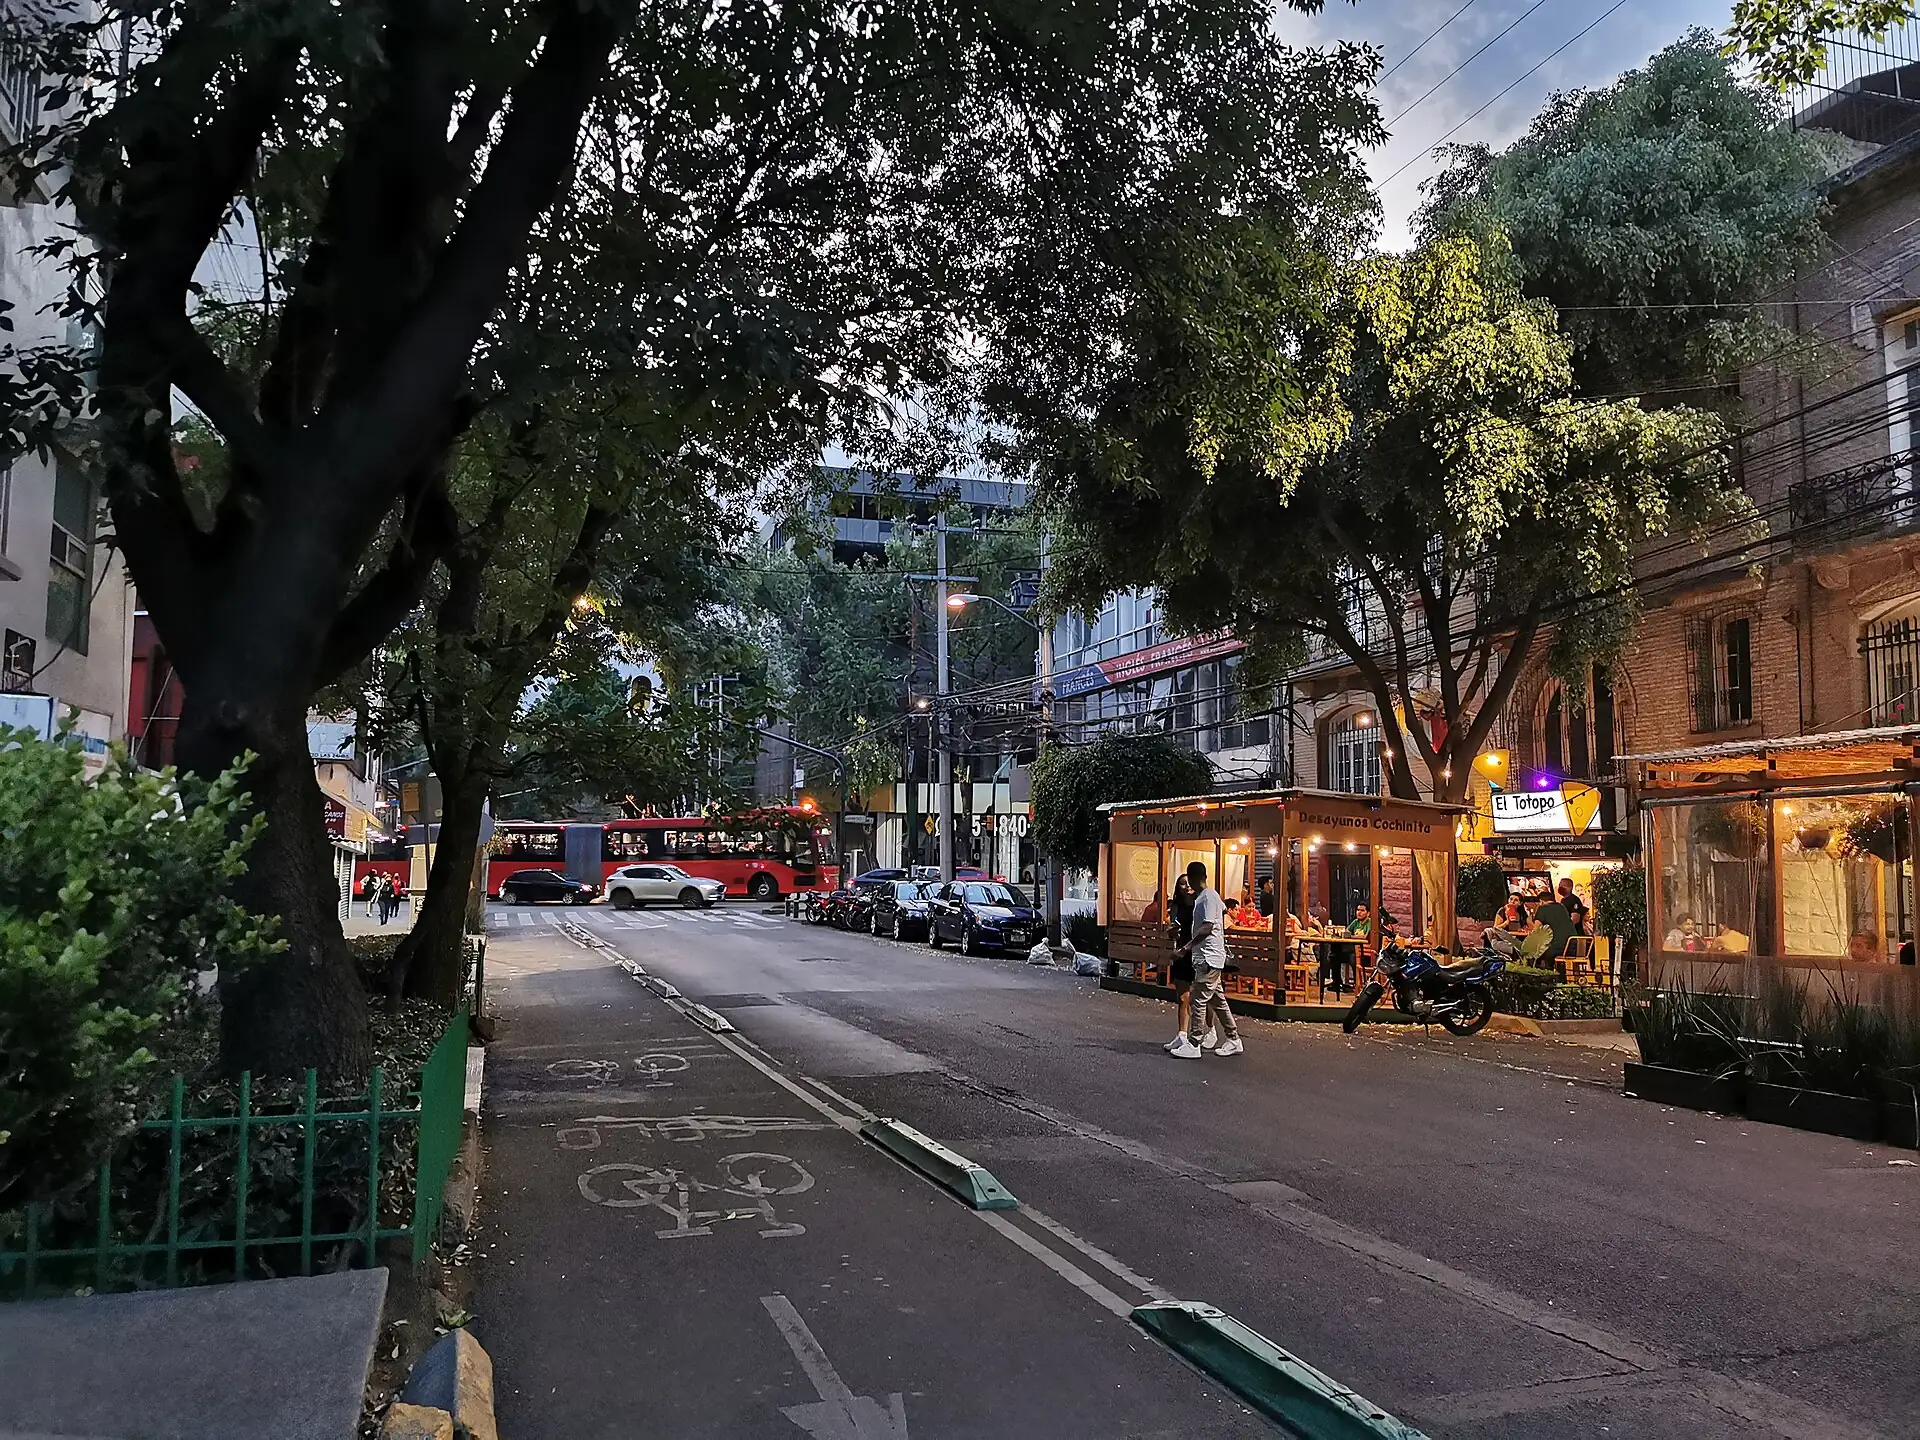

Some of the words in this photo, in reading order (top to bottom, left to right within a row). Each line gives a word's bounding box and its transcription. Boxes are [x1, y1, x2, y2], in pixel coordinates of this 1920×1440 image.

[1495, 796, 1508, 811] El
[1512, 794, 1555, 813] Totopo
[1132, 820, 1140, 835] El
[1143, 820, 1173, 838] Totopo
[1298, 811, 1369, 829] Desayunos
[1373, 818, 1432, 834] Cochinita
